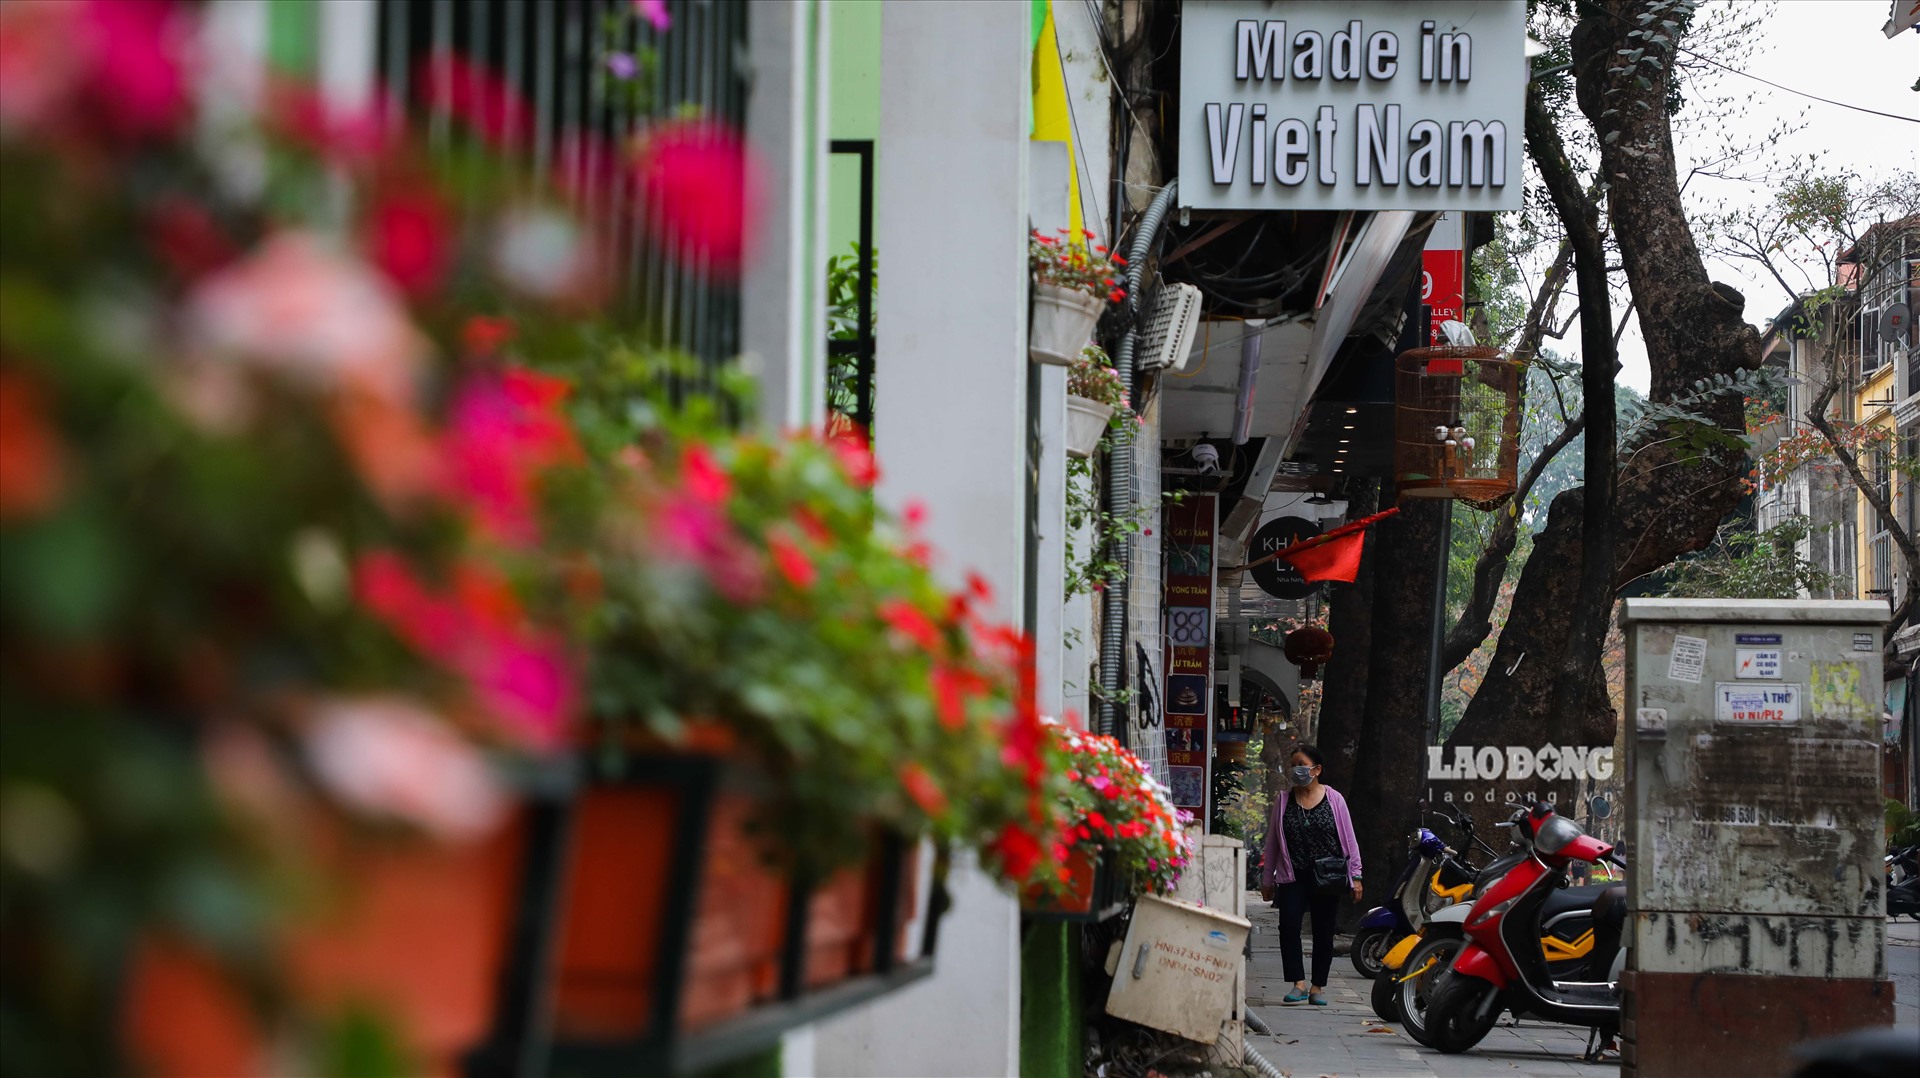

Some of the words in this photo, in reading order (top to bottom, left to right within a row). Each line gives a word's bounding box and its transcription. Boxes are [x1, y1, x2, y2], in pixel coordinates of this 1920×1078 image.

[1235, 19, 1398, 81] Made
[1420, 20, 1472, 82] in
[1204, 103, 1337, 187] Viet
[1355, 104, 1507, 189] Nam
